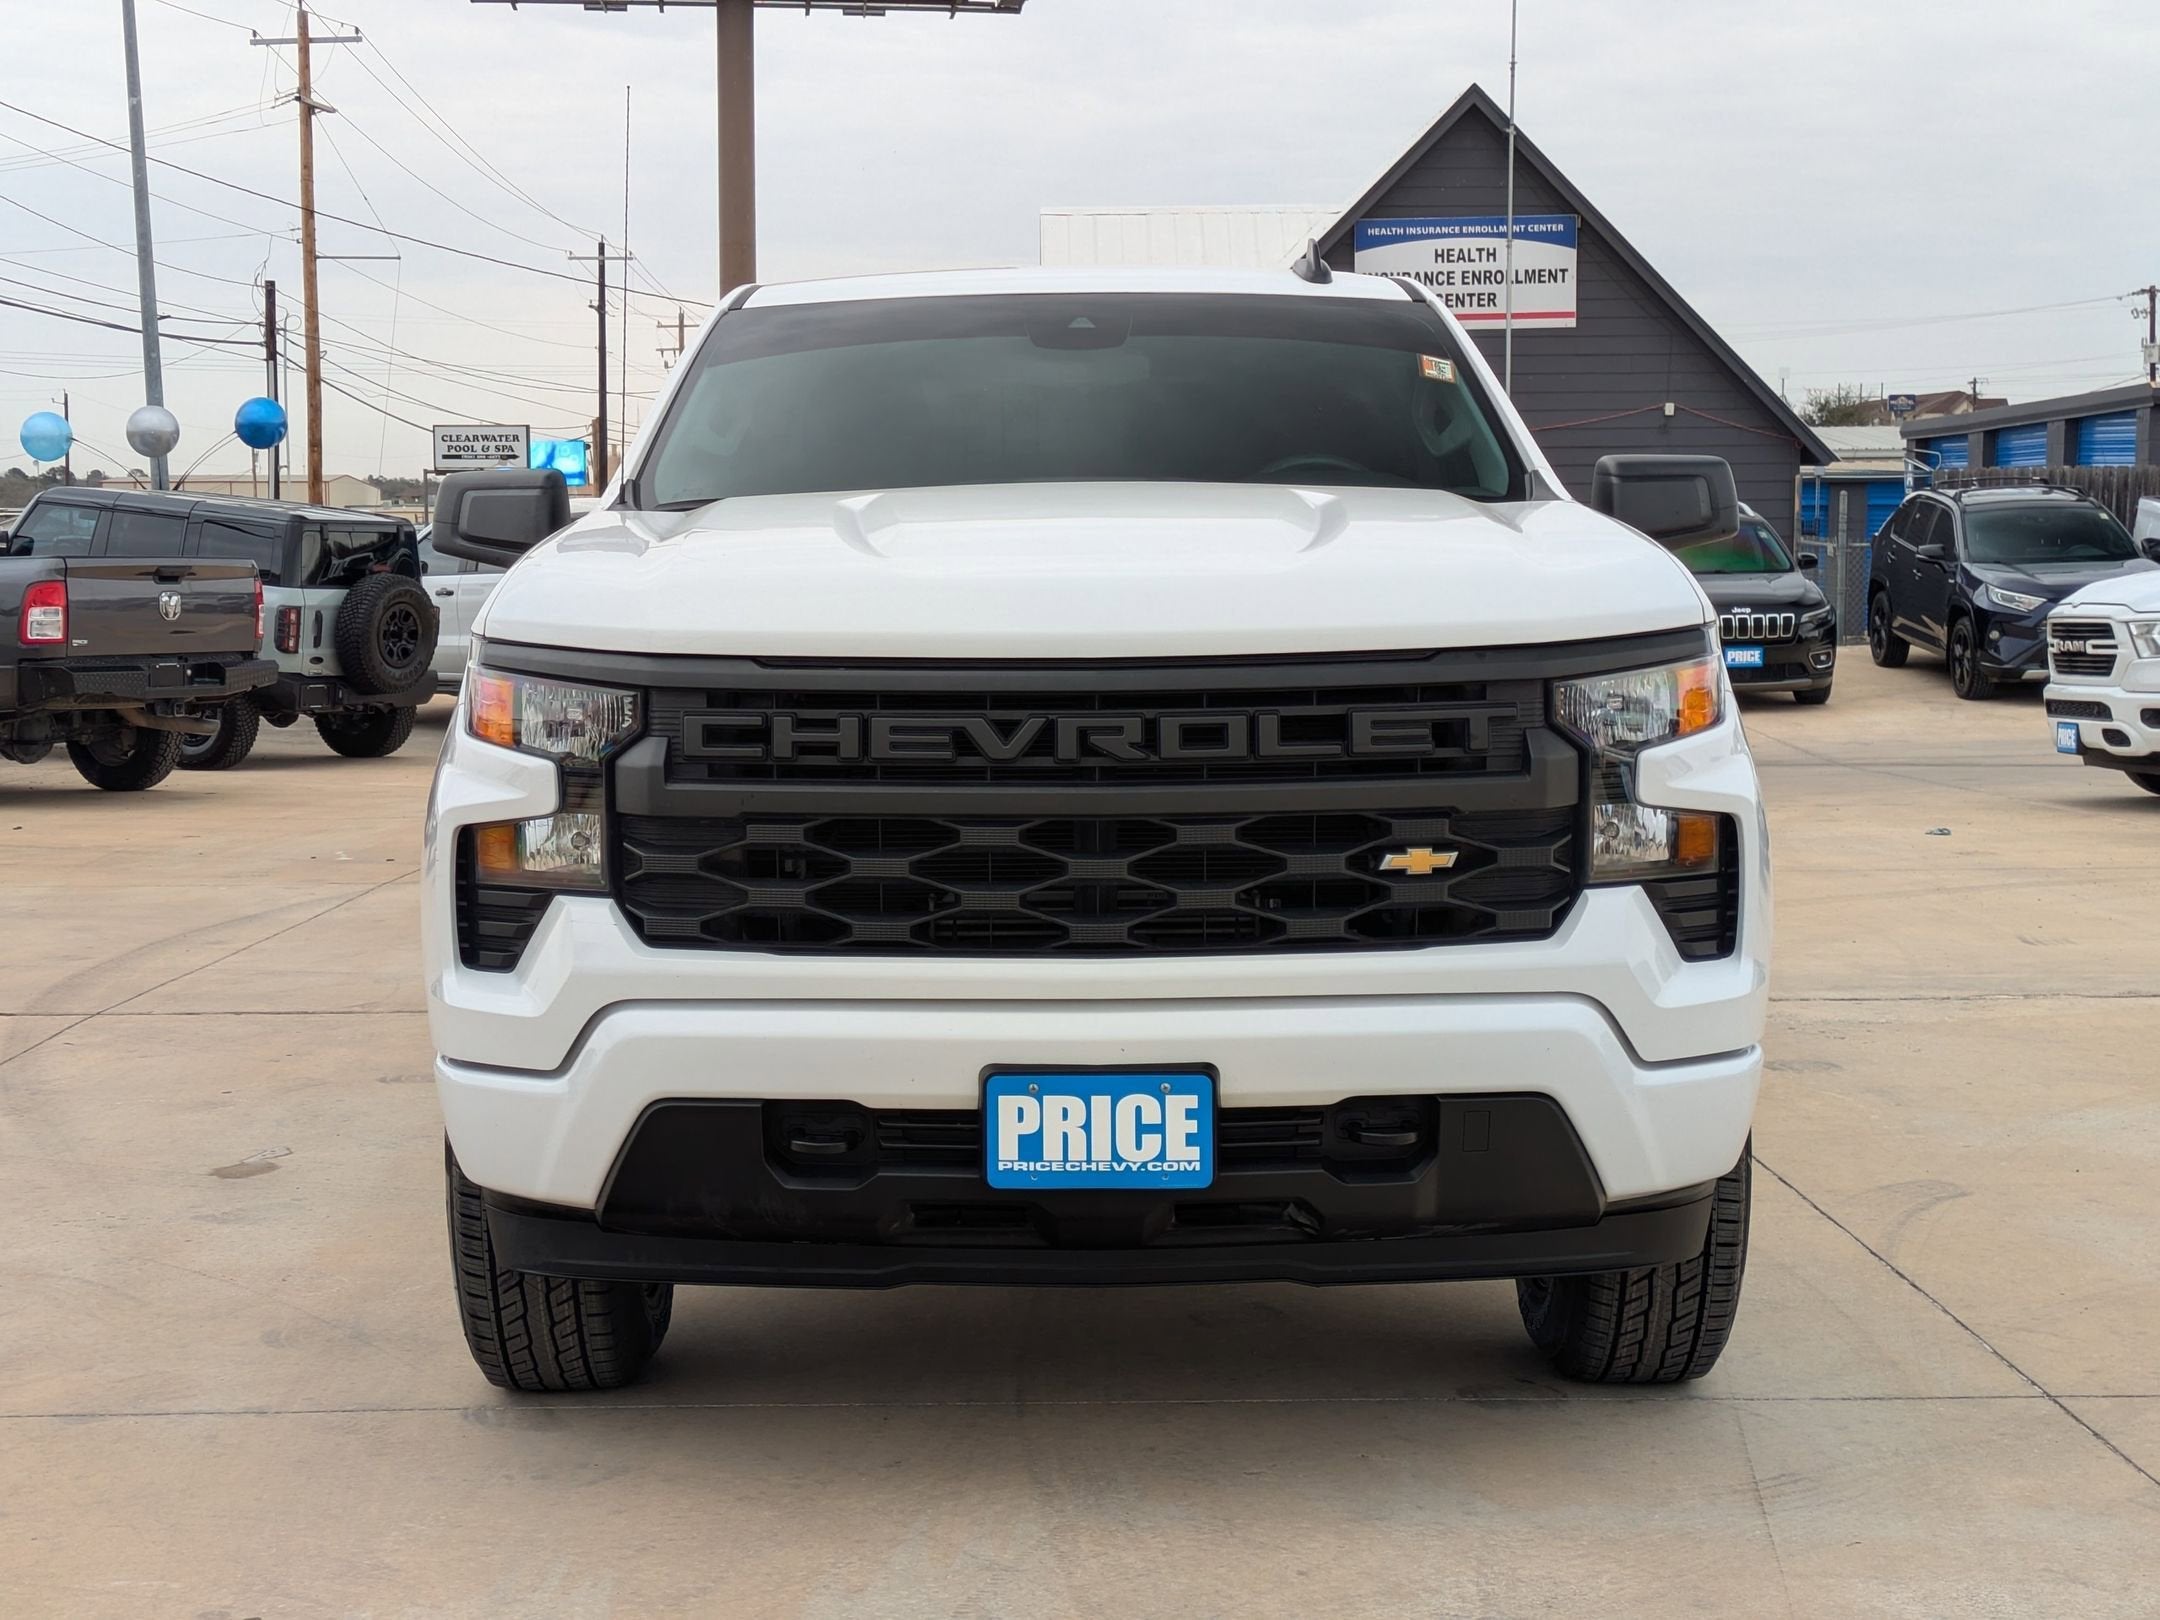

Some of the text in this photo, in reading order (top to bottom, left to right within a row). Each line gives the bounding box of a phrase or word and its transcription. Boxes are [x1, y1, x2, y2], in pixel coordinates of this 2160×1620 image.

[1367, 223, 1564, 236] HEALTH INSURANCE ENROLLMNT CENTER
[1434, 247, 1497, 264] HEALTH
[441, 434, 520, 443] CLEARWATER
[447, 445, 515, 453] POOL & SPA
[1731, 606, 1752, 614] Jeep
[2054, 639, 2085, 653] RAM
[1727, 650, 1761, 662] PRICE
[682, 703, 1518, 763] CHEVROLET
[2057, 727, 2076, 746] PRICE
[997, 1093, 1200, 1162] PRICE
[998, 1161, 1201, 1172] PRICECHEVY.COM
